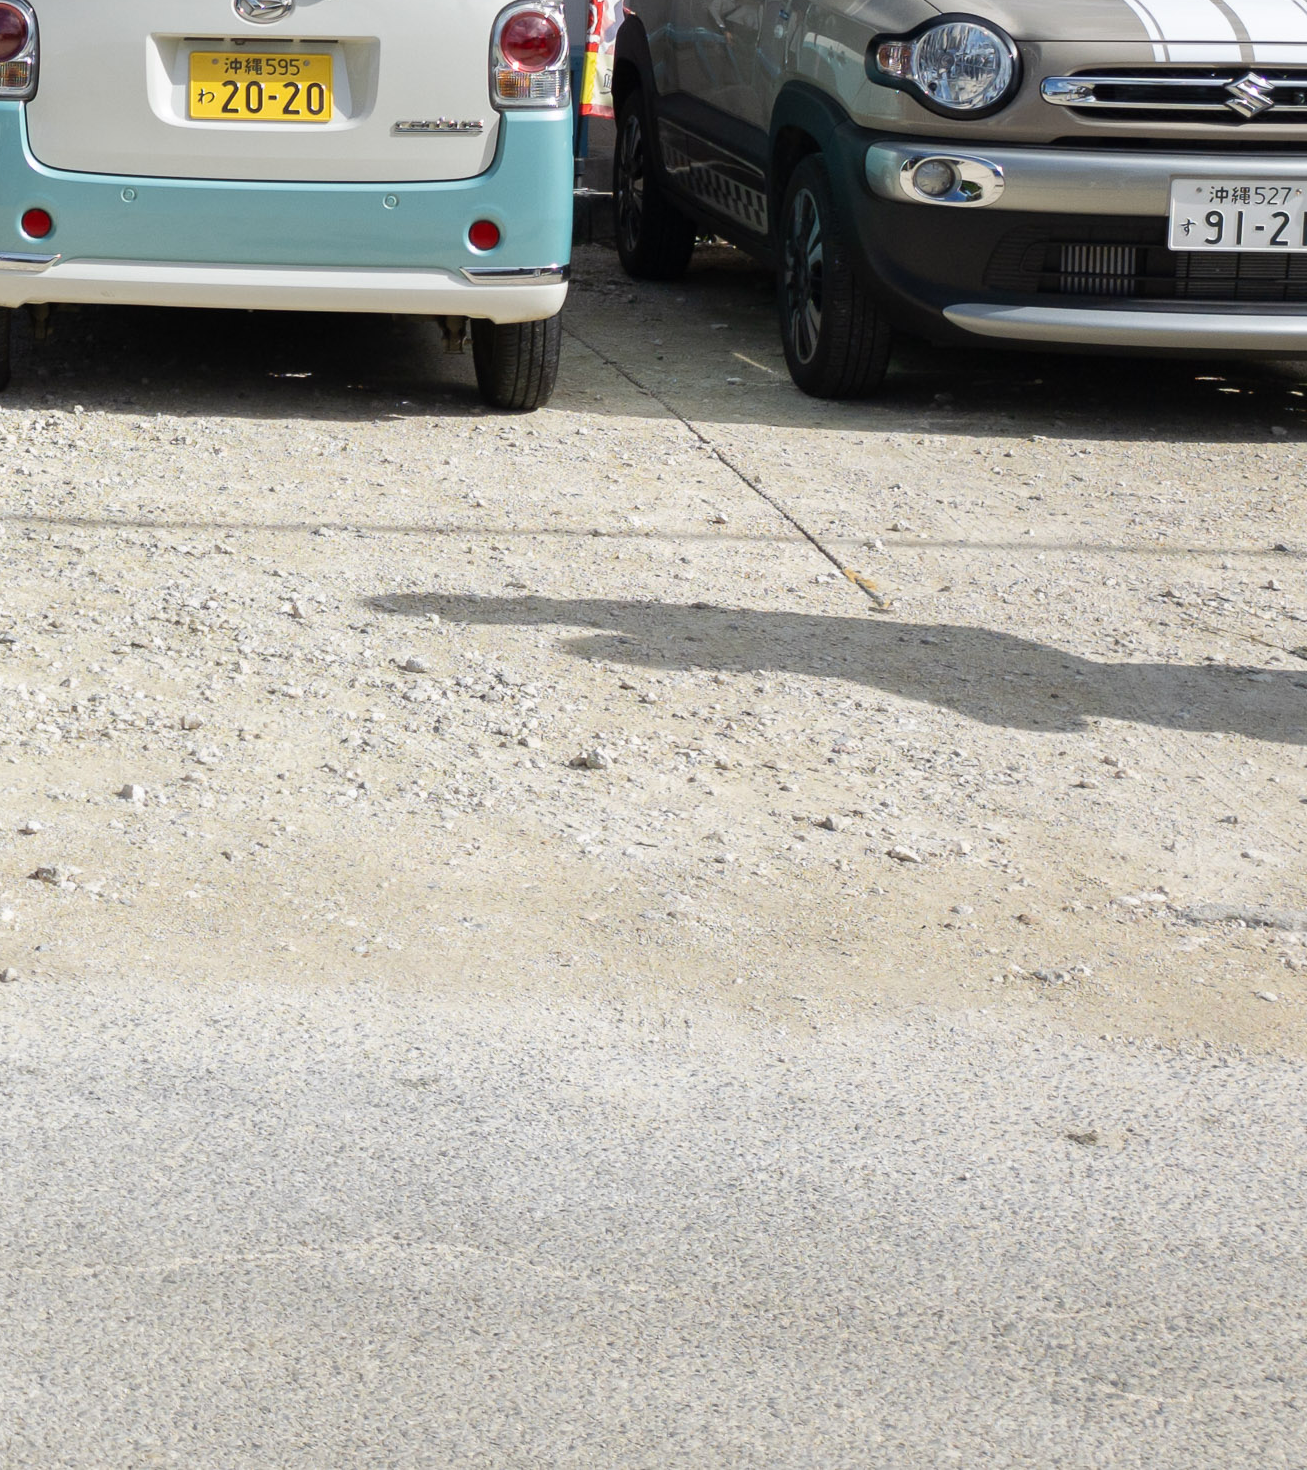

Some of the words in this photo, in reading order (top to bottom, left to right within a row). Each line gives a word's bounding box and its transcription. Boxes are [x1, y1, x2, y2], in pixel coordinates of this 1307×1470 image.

[198, 88, 216, 105] わ
[221, 80, 325, 116] 20-20
[1180, 217, 1196, 237] す
